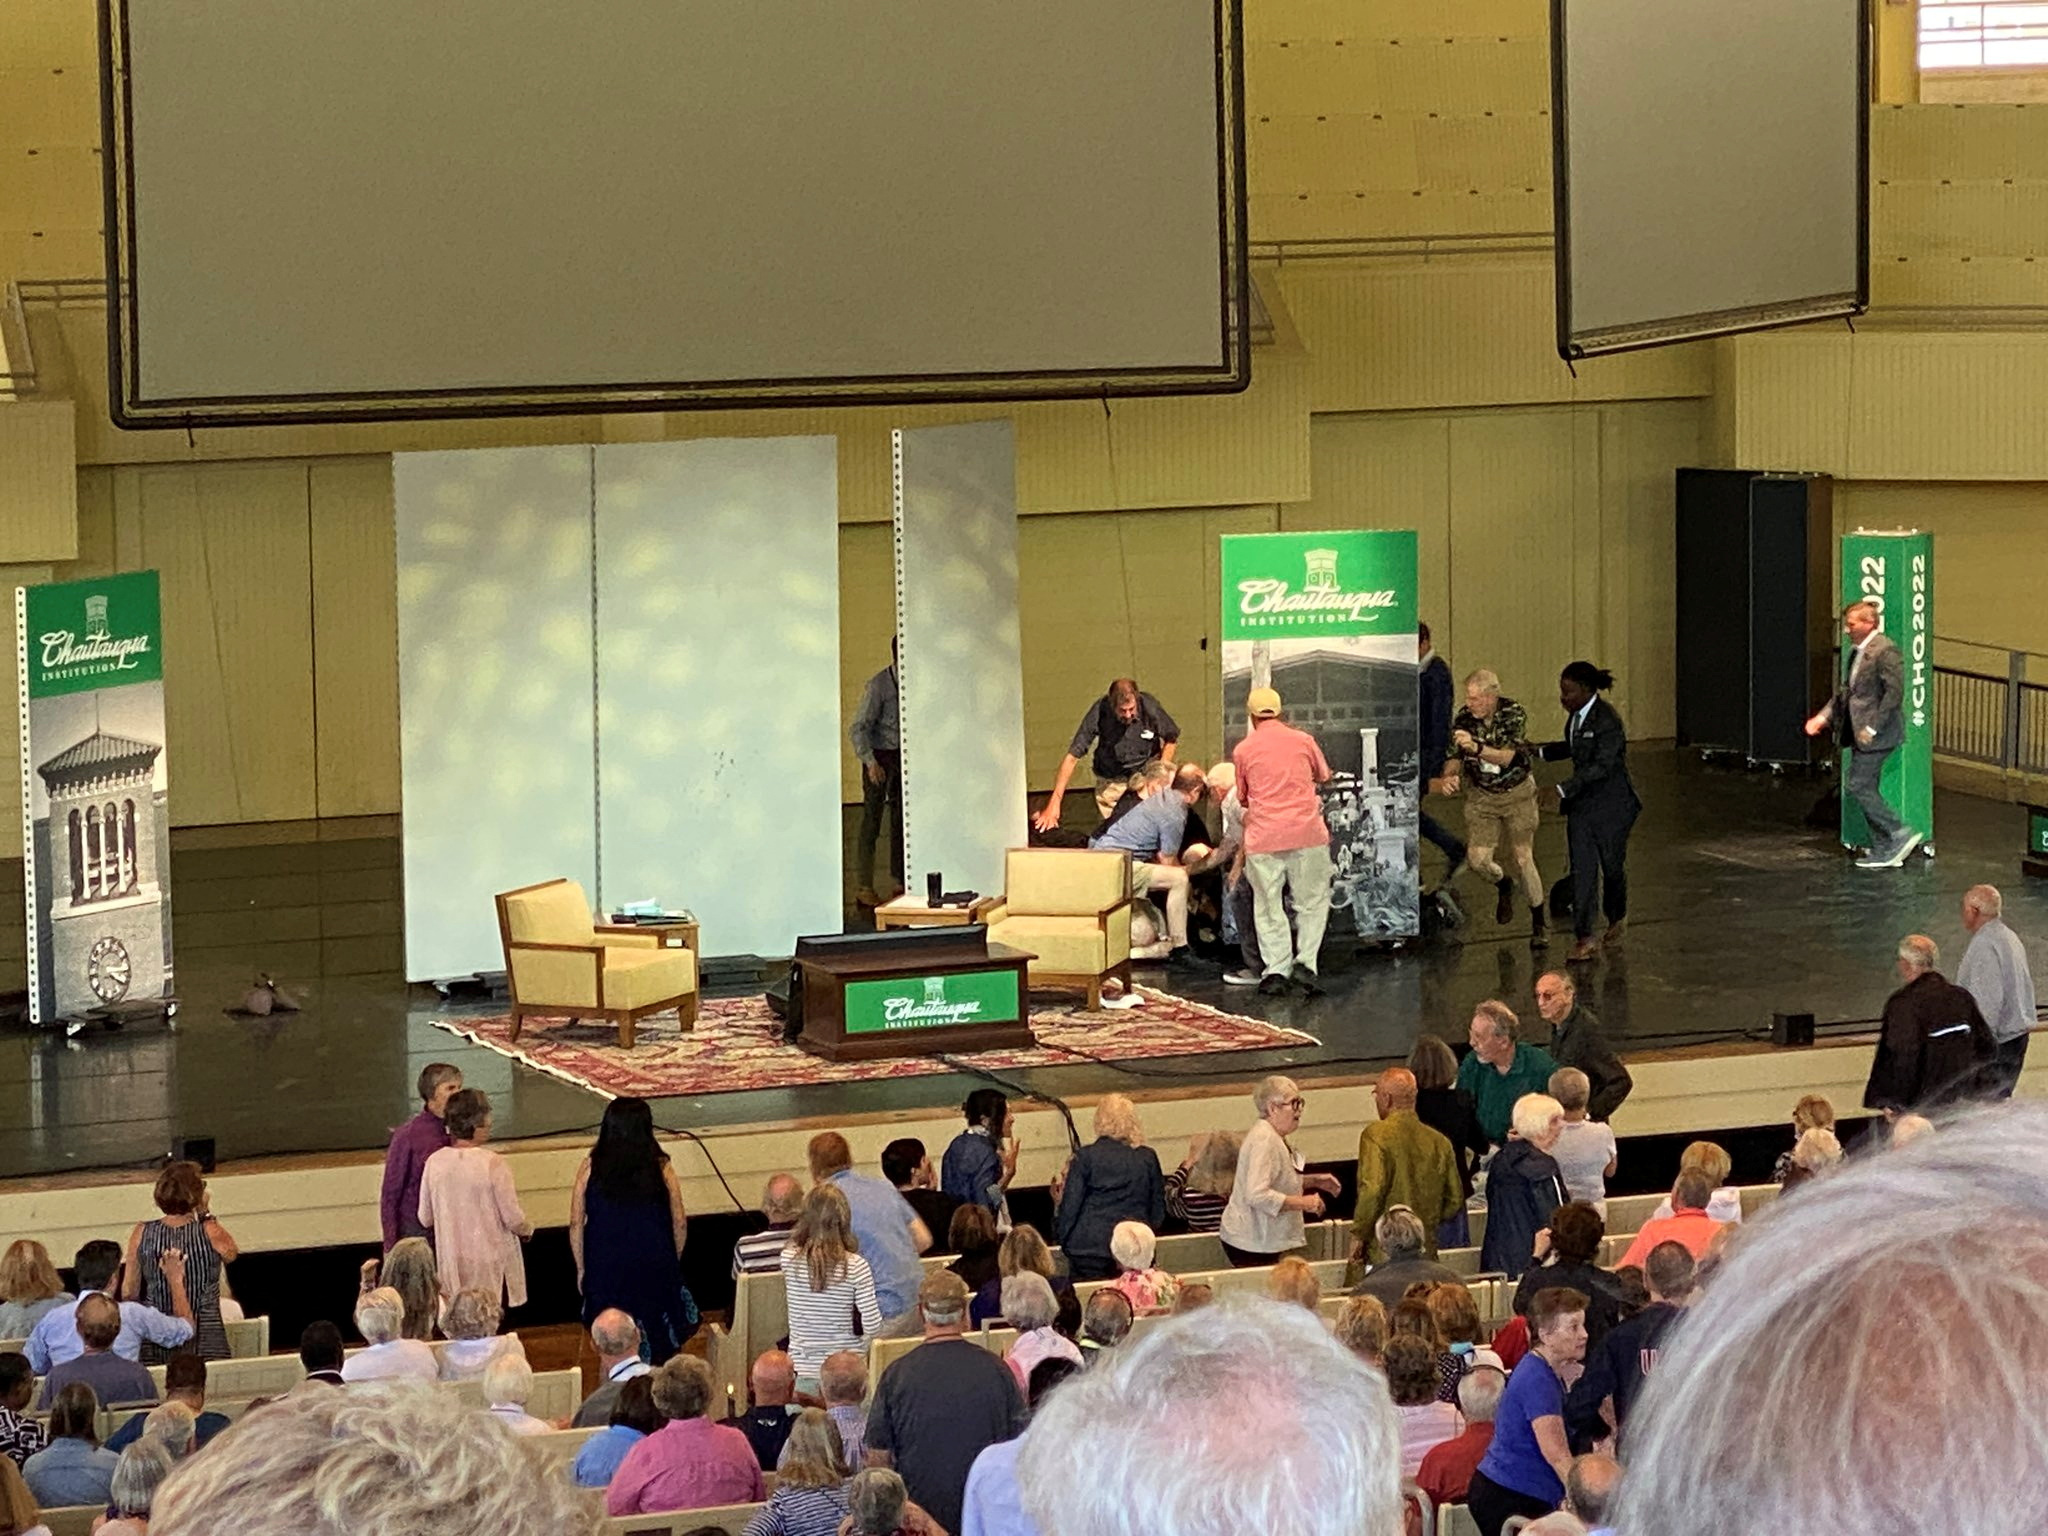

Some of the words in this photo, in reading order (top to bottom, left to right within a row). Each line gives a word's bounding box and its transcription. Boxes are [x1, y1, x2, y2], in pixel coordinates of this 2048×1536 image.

[1238, 578, 1397, 622] Chautauqua
[1240, 613, 1351, 628] INSTITUTION
[40, 629, 150, 670] Chautauqua
[1912, 554, 1926, 728] #CHQ2022
[42, 662, 117, 682] INSTITUTION
[883, 997, 981, 1023] Chautauqua
